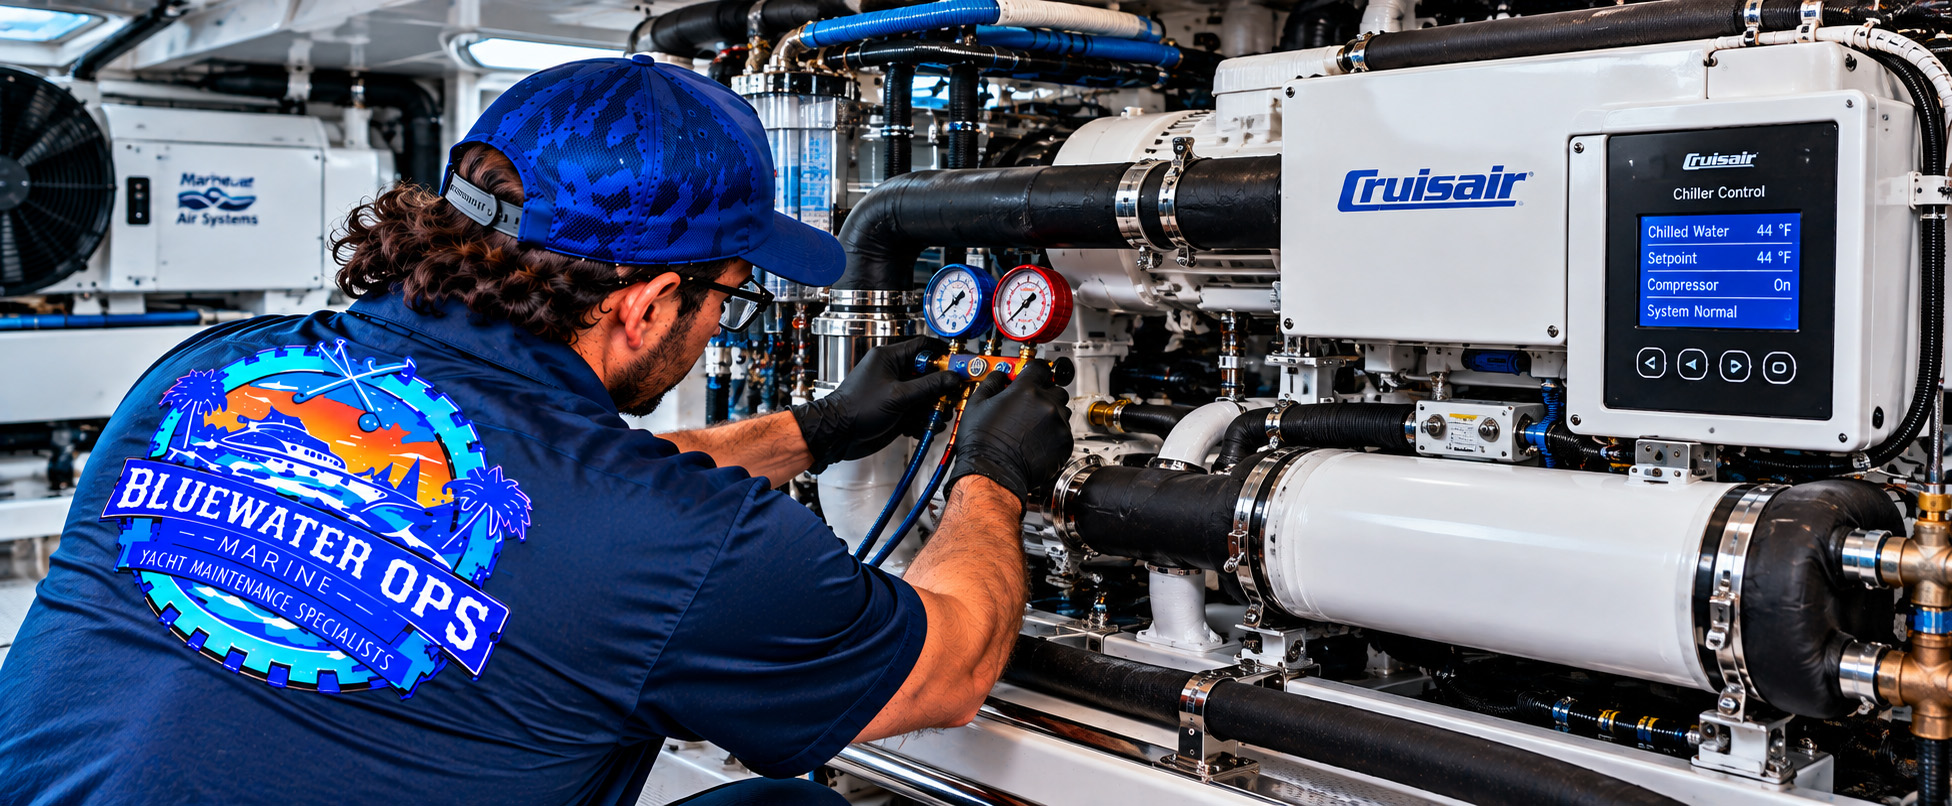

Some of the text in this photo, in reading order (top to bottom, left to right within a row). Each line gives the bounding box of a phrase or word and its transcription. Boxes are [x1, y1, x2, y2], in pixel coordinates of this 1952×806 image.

[1683, 151, 1757, 170] Cruisair
[1337, 165, 1528, 213] Cruisair
[1673, 185, 1766, 200] Chiller Control
[177, 212, 259, 228] Air Systems
[1648, 225, 1689, 238] Chilled
[1693, 224, 1730, 238] Water
[1756, 224, 1773, 237] 44
[1648, 251, 1698, 267] Setpoint
[1756, 251, 1773, 264] 44
[1647, 278, 1791, 295] Compressor On
[1647, 303, 1738, 320] System Normal
[116, 467, 490, 652] BLUEWATER OPS
[217, 535, 332, 596] MARINE
[139, 549, 395, 671] YACHT MAINTENANCE SPECIALISTS
